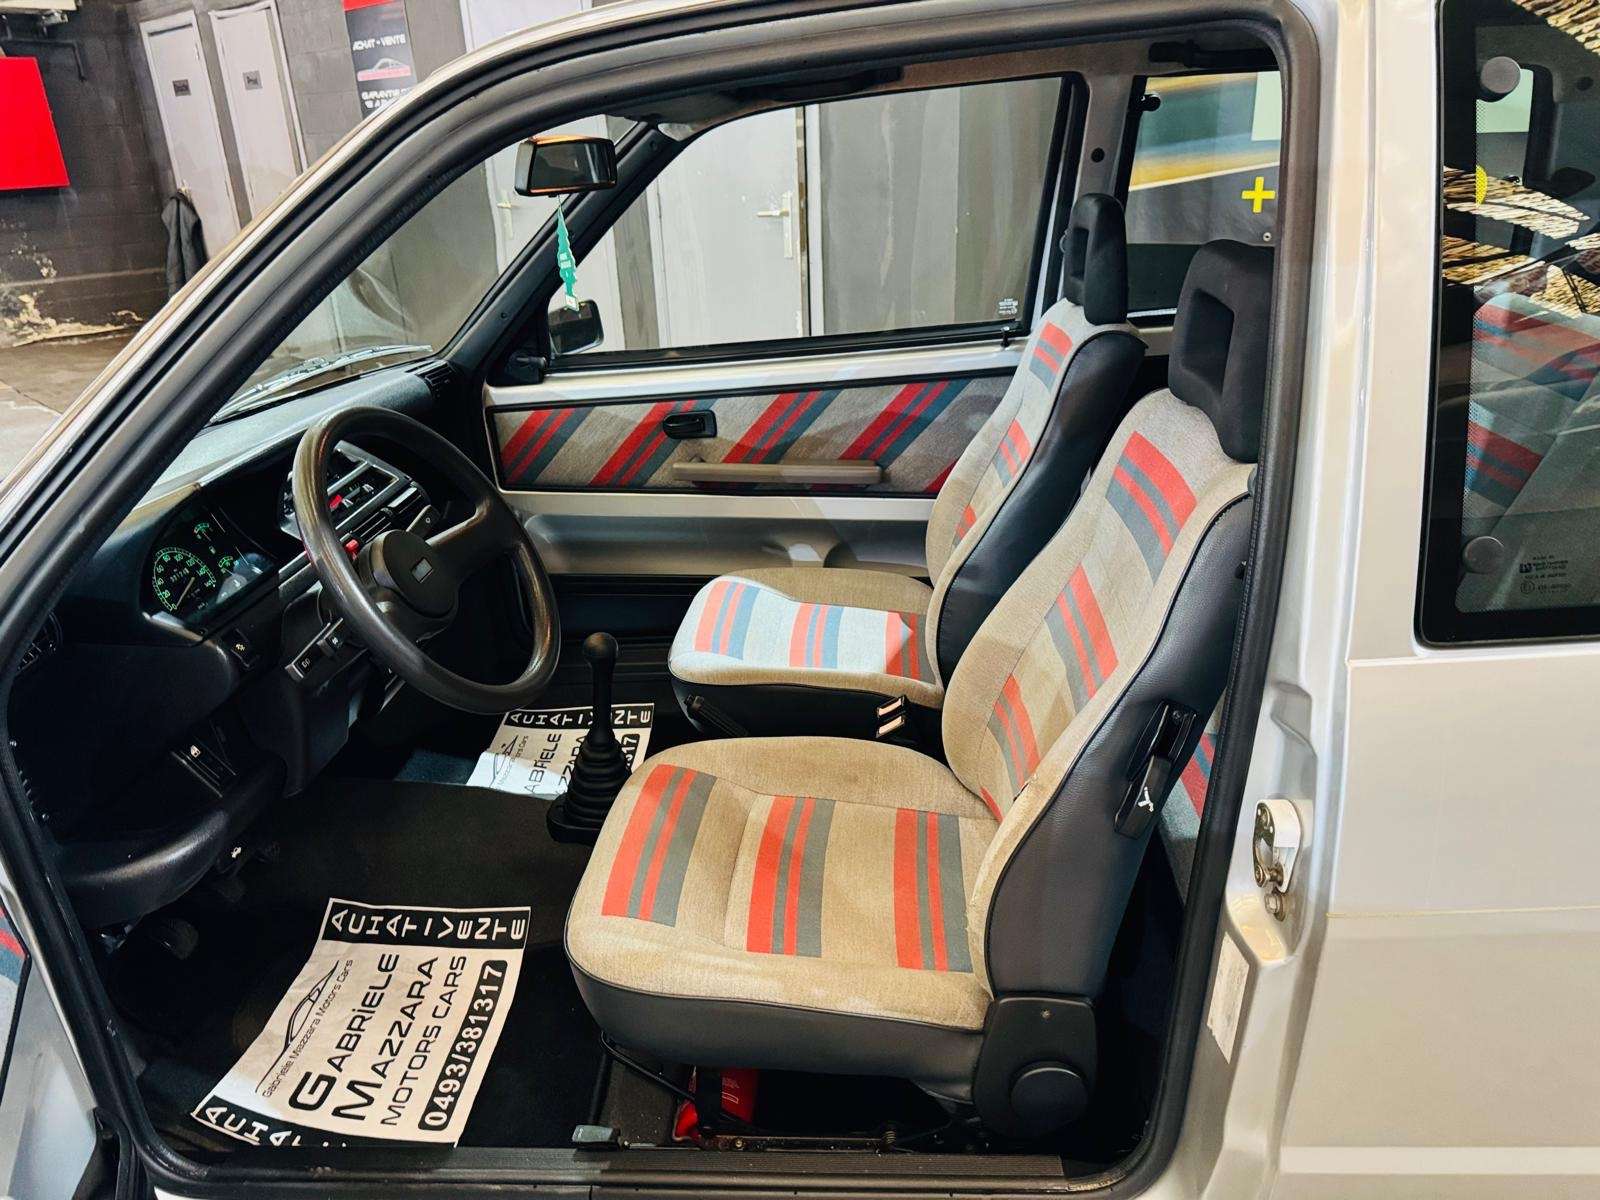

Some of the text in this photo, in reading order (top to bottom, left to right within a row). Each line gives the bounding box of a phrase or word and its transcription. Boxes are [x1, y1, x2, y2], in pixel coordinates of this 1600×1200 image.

[380, 34, 406, 47] VENTE
[291, 1017, 320, 1060] Mazzara
[317, 984, 342, 1017] Motors
[337, 959, 353, 983] Cars
[332, 956, 438, 1121] MAZZARA
[380, 955, 467, 1126] MOTORS CARS
